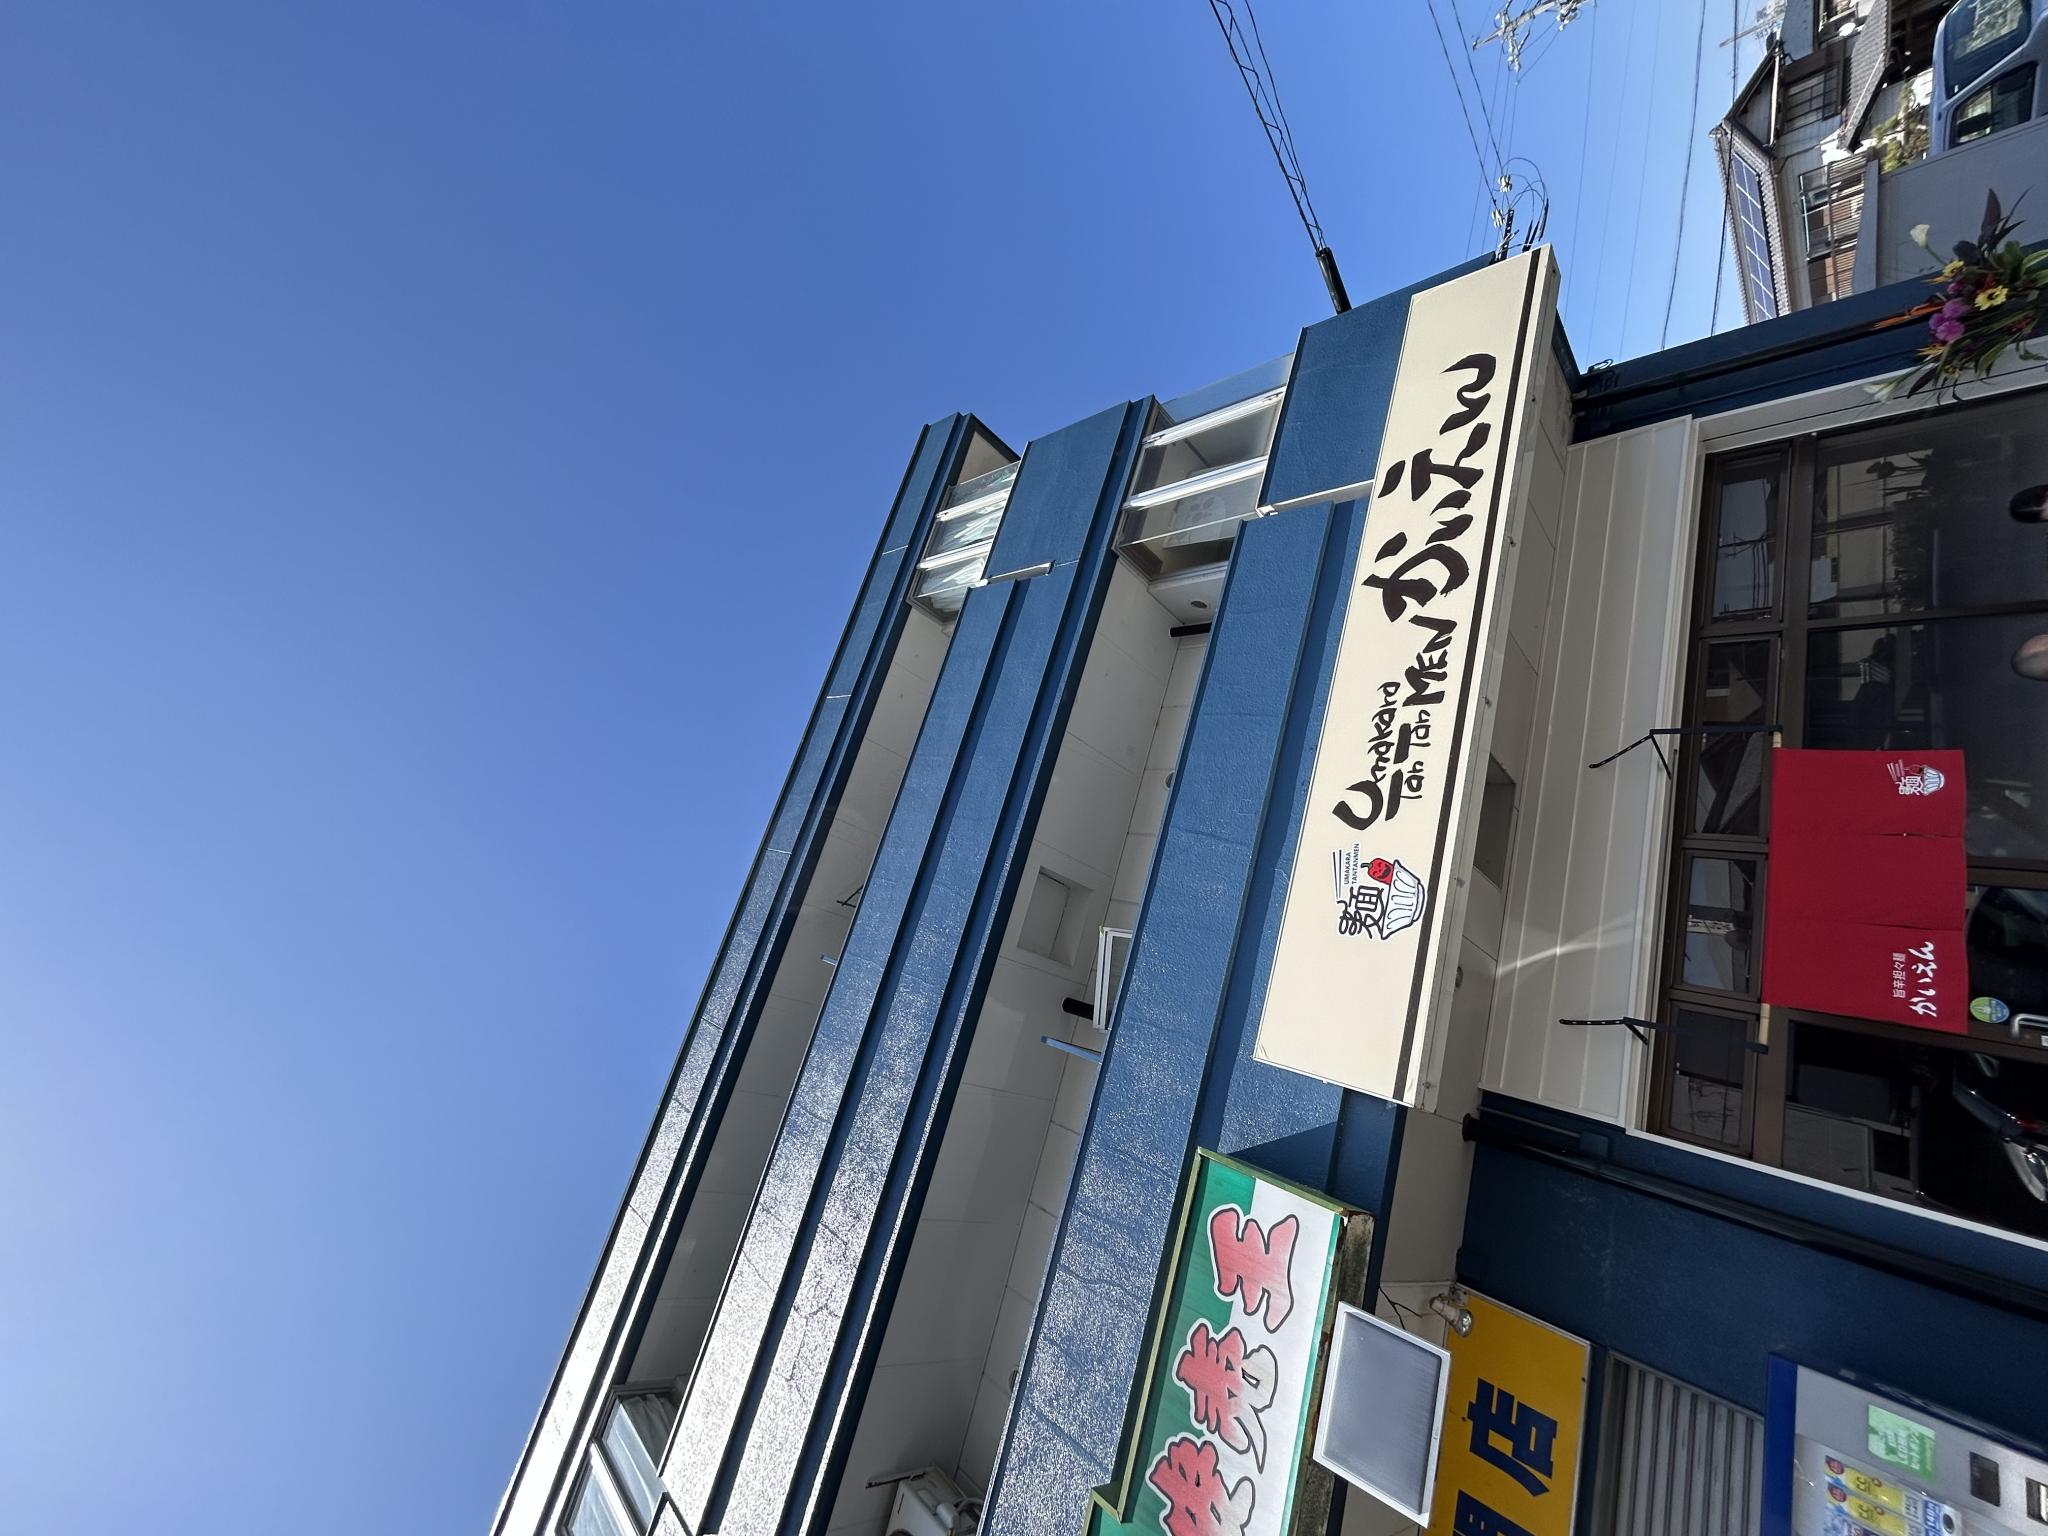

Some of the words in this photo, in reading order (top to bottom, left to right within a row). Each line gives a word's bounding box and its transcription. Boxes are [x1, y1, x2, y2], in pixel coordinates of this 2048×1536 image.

[1361, 352, 1496, 623] かいえん
[1401, 614, 1458, 706] MEN
[1332, 680, 1401, 830] Umakara
[1907, 941, 1938, 1018] かいえん
